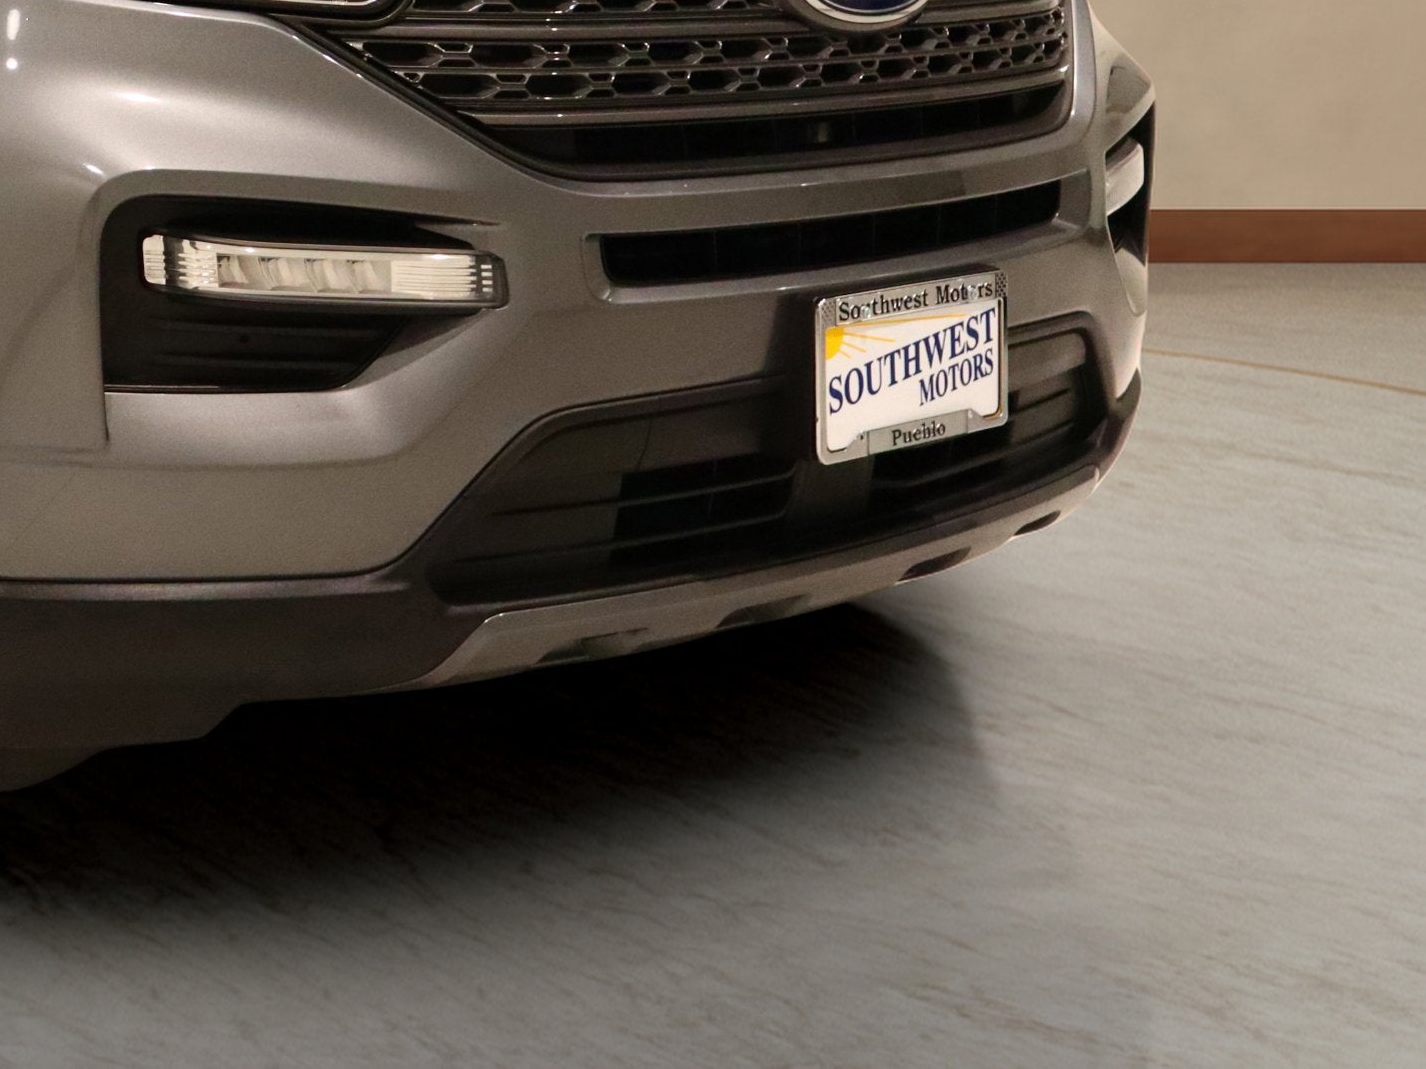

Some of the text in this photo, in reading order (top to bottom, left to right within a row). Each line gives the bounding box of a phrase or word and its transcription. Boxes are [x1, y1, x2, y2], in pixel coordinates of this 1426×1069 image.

[935, 282, 994, 305] Motrs
[829, 308, 996, 414] SOUTHWEST
[919, 348, 994, 406] MOTORS
[892, 422, 946, 445] Pueblo
